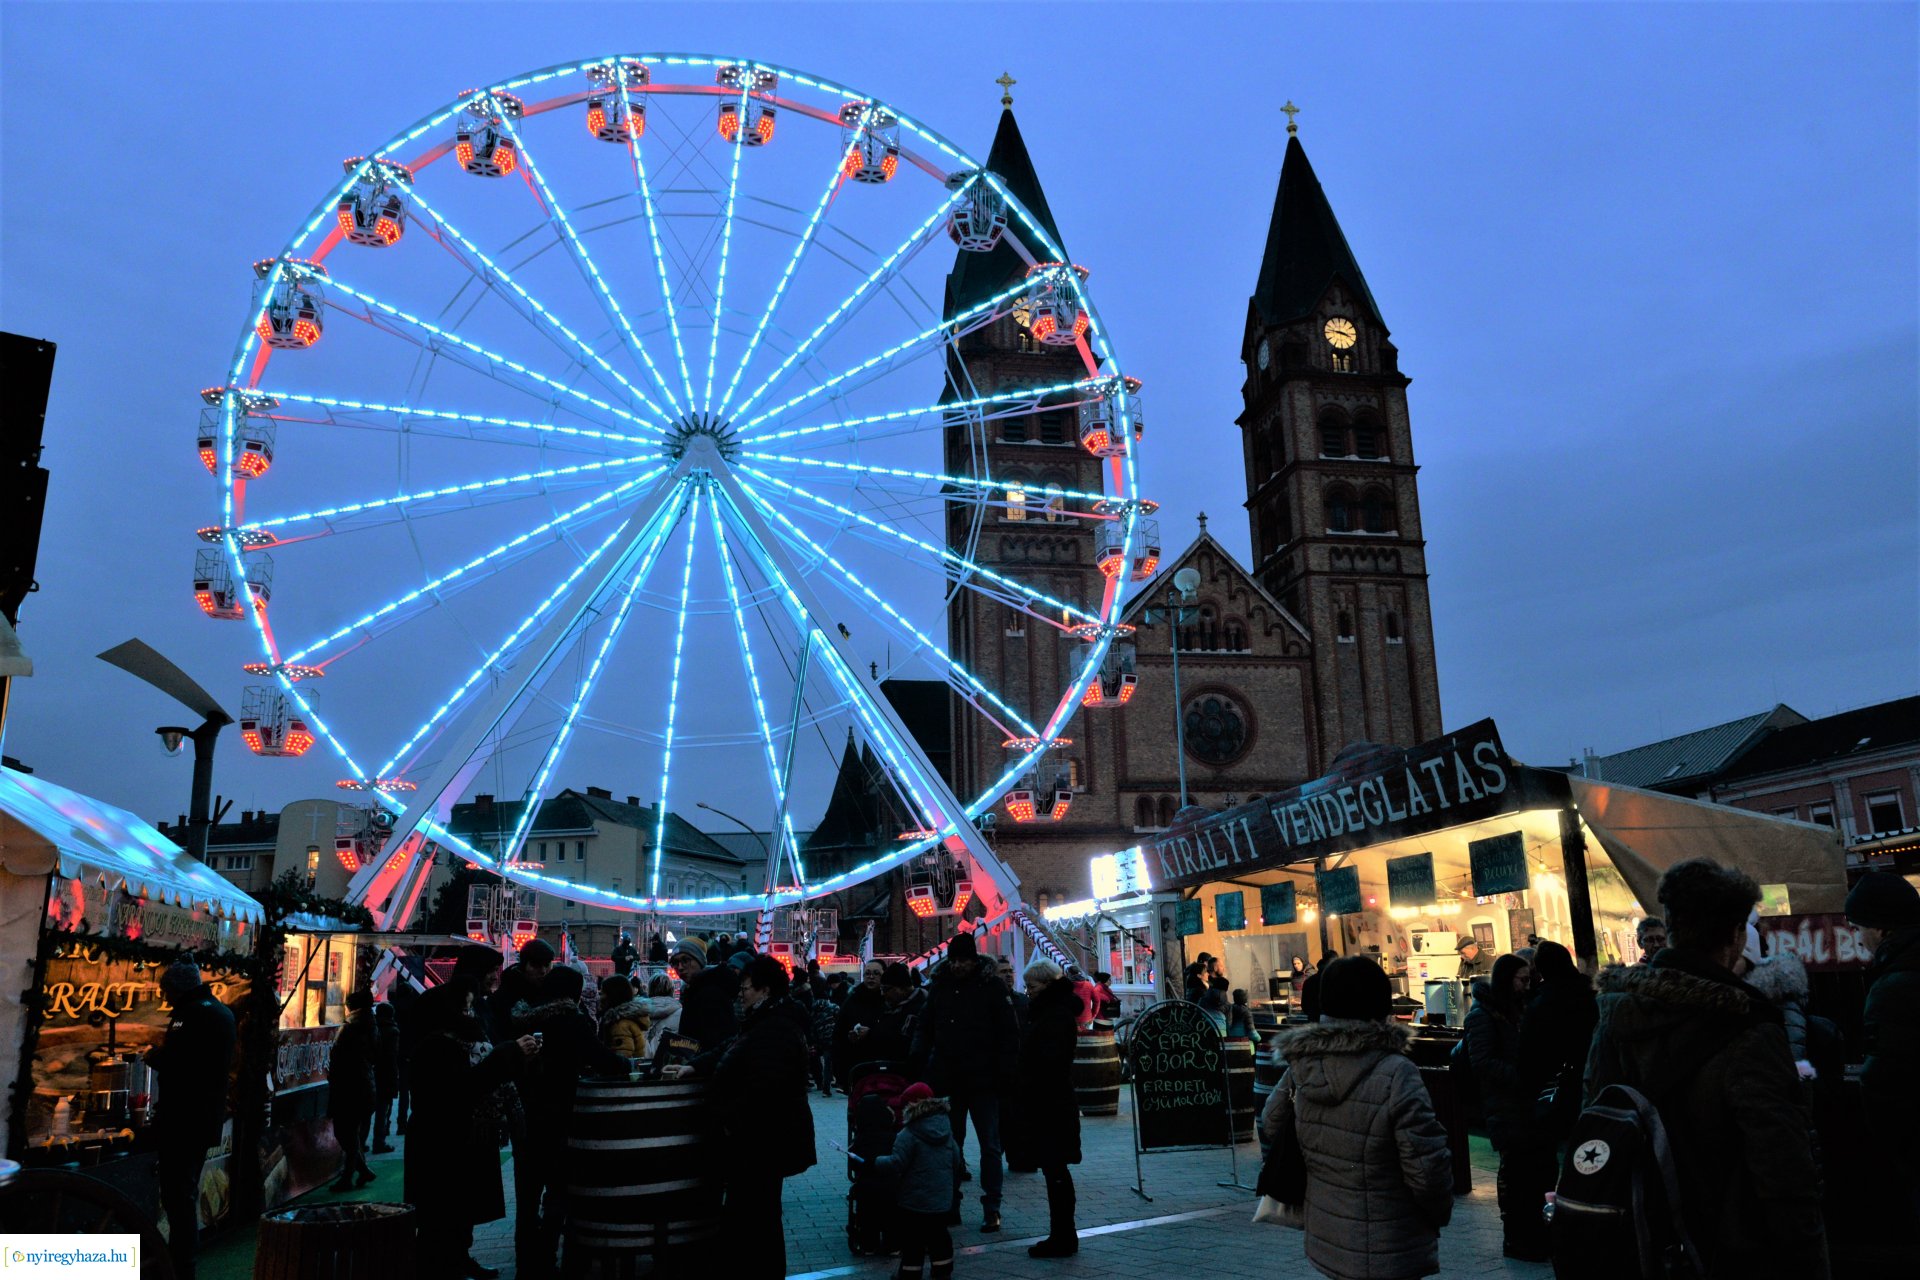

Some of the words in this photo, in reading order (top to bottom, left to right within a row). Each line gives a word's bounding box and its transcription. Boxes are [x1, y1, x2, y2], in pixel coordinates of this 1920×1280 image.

[1155, 818, 1259, 880] KIRÁLYI
[1271, 737, 1507, 847] VENDÉGLÁTÁS
[43, 982, 146, 1018] RALT
[1158, 1032, 1206, 1051] EPER
[1156, 1051, 1207, 1073] BOR
[1143, 1080, 1207, 1093] EREDETI
